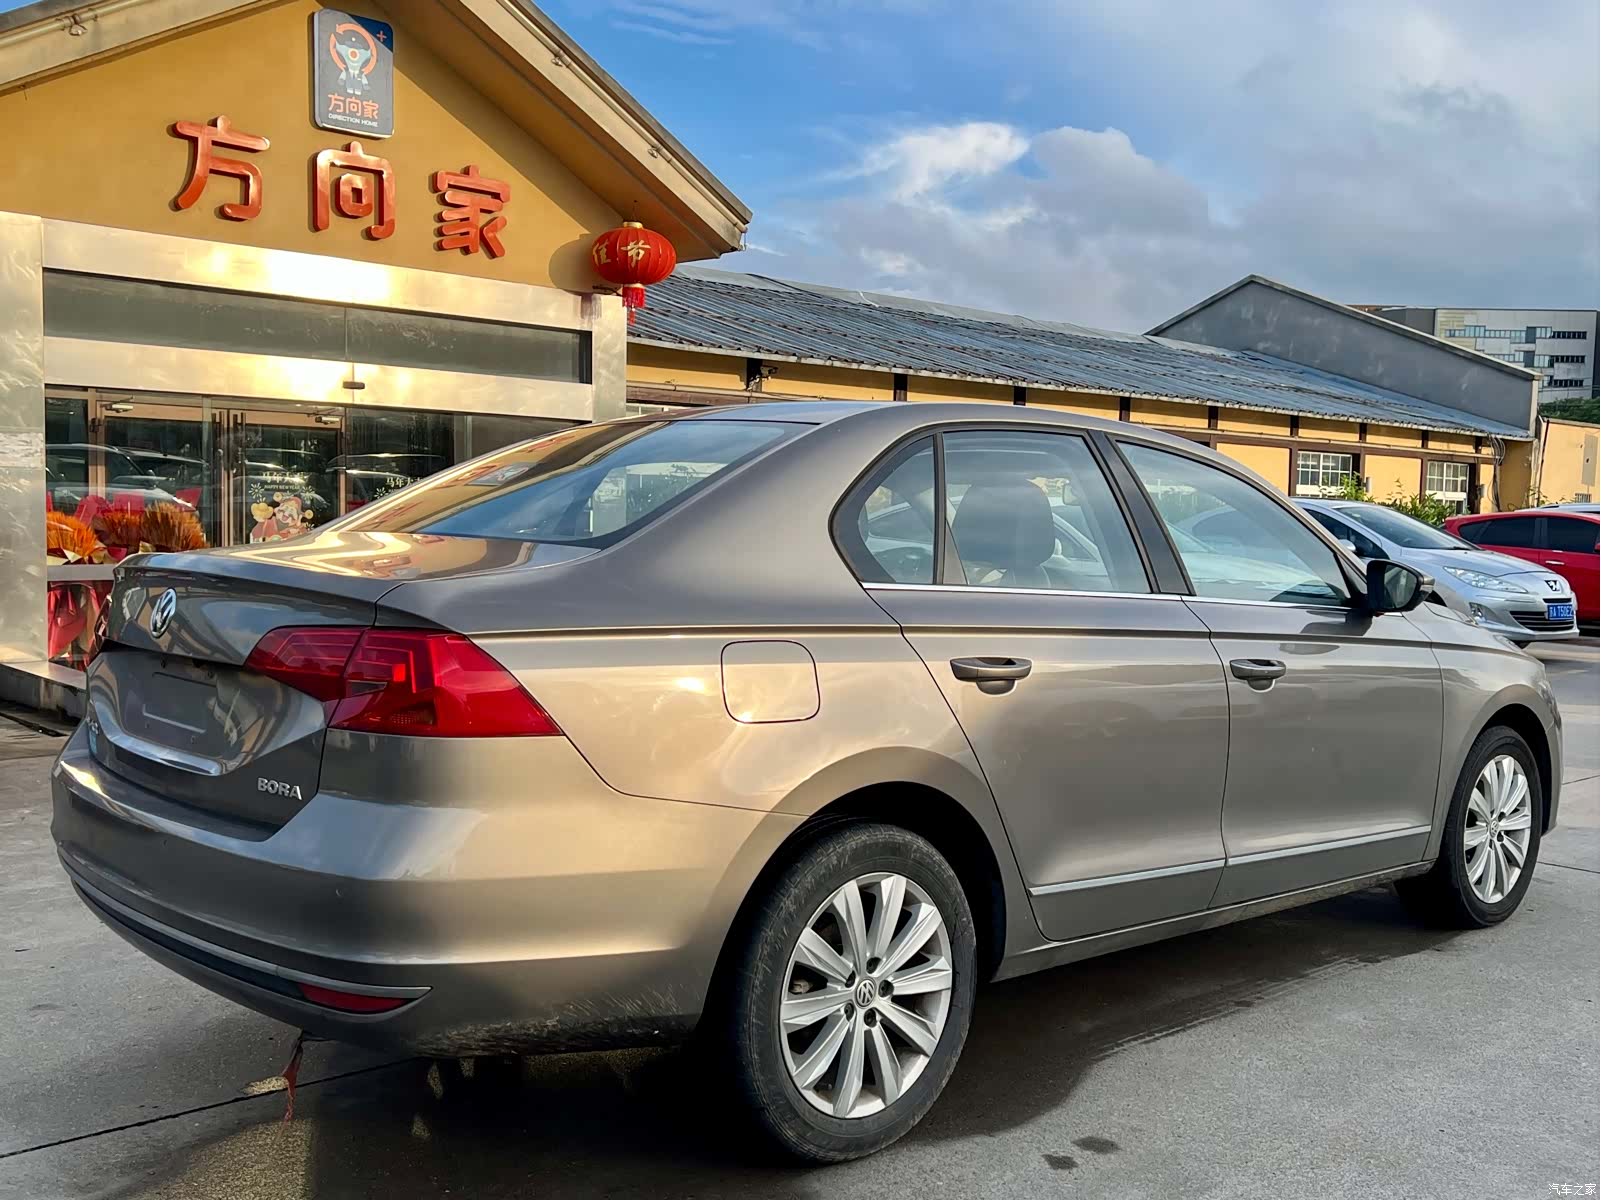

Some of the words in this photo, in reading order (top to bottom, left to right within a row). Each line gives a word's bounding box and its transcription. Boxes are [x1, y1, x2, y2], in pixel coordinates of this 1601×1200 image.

[327, 92, 380, 119] 方向家
[328, 113, 360, 123] DIRECTION
[361, 119, 379, 127] HOME
[175, 115, 511, 258] 方向家
[257, 777, 303, 801] BORA
